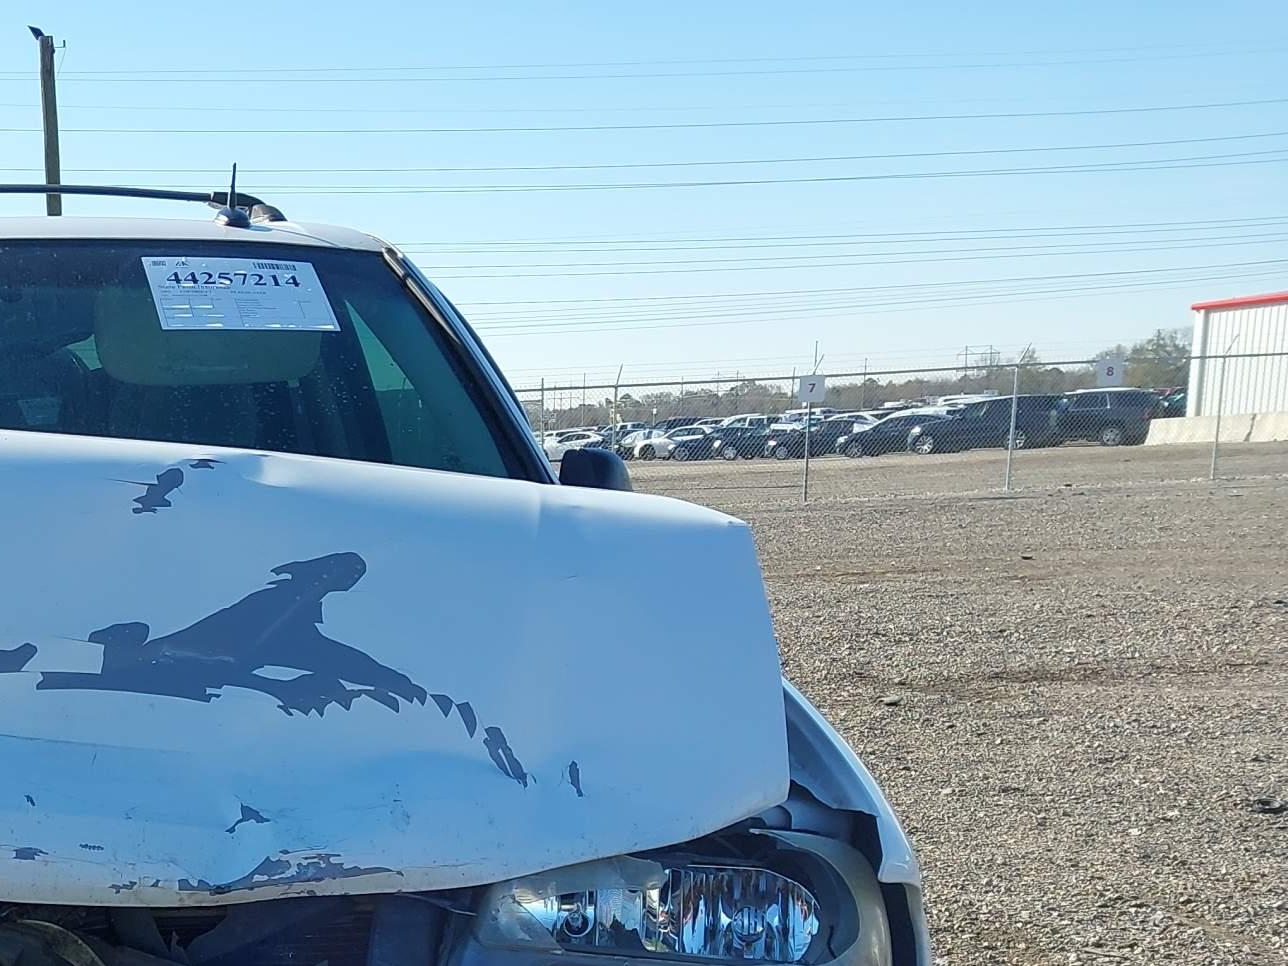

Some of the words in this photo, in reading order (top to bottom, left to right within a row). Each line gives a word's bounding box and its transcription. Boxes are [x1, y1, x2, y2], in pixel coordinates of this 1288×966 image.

[166, 271, 301, 288] 44257214
[1106, 366, 1114, 376] 8
[808, 383, 816, 392] 7
